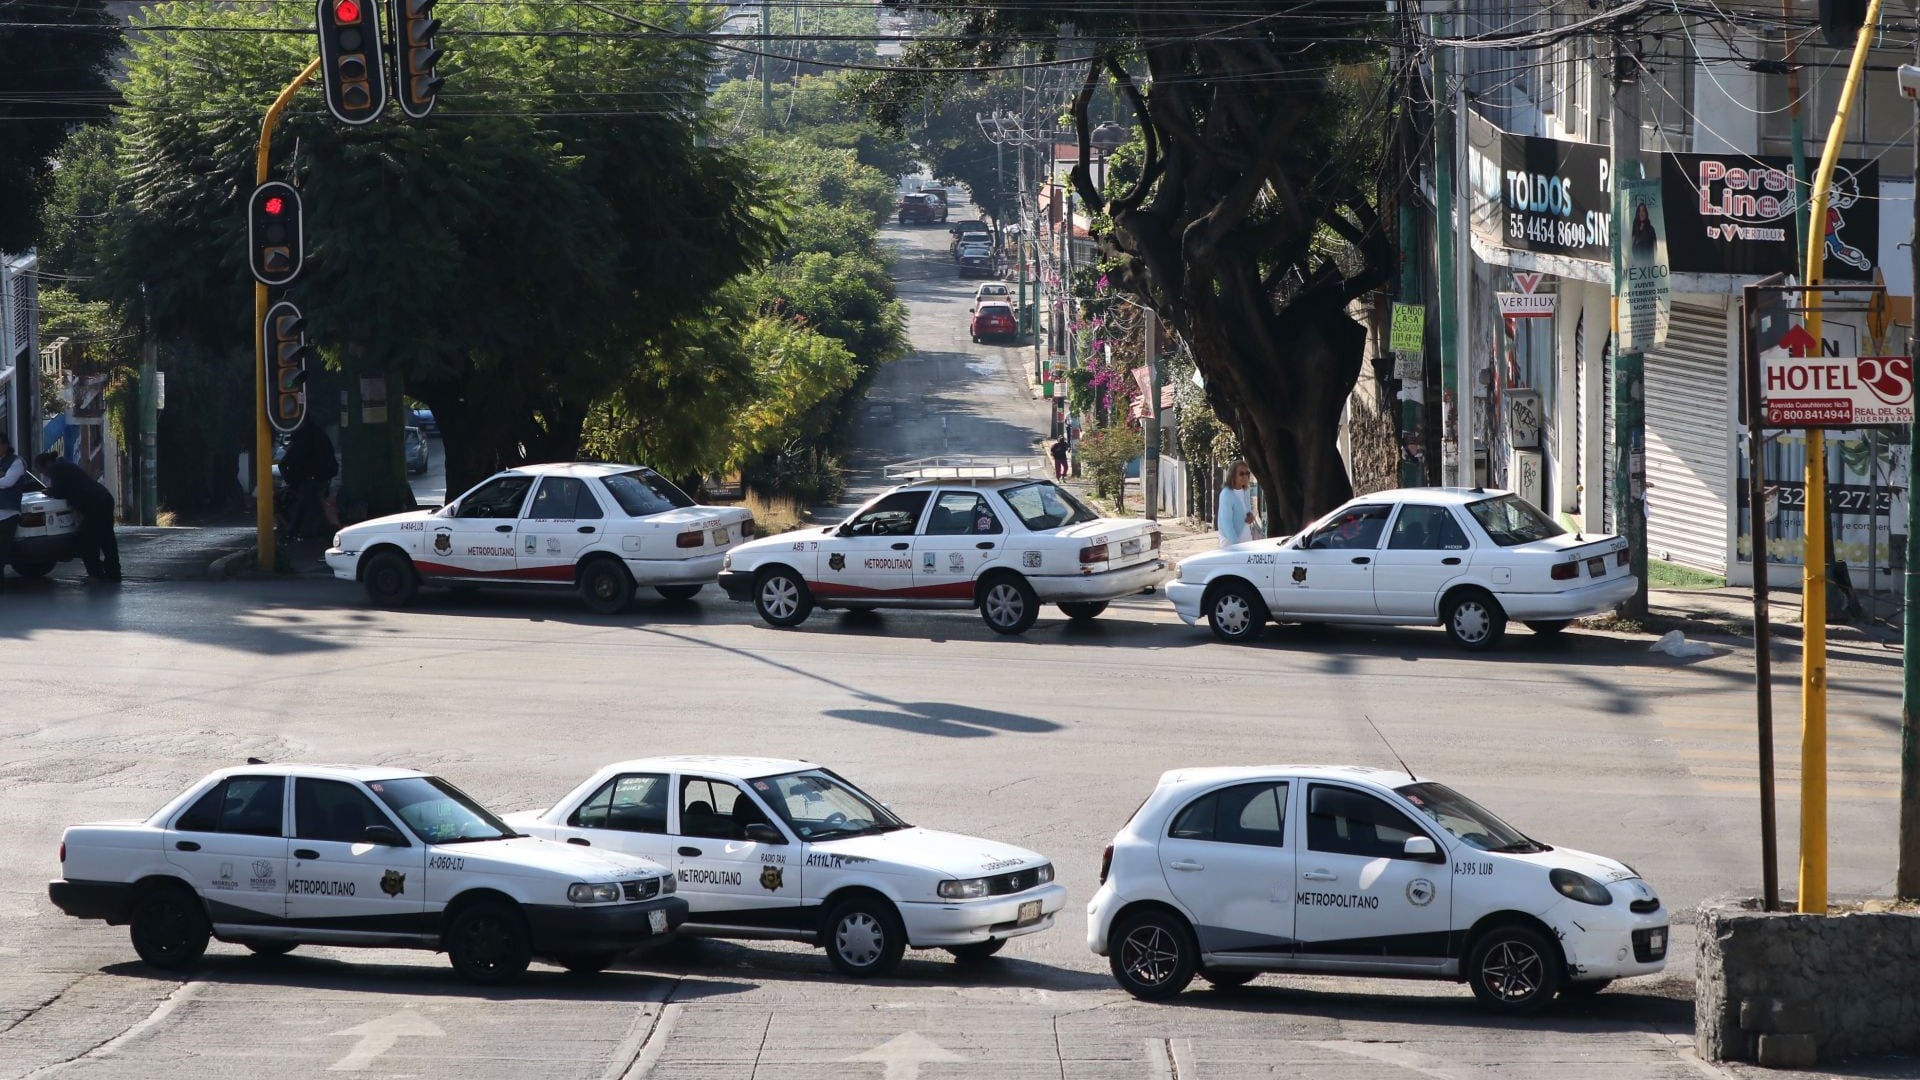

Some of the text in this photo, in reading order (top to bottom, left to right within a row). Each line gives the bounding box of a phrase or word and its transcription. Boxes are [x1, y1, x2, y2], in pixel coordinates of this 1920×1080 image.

[1700, 160, 1796, 192] Persi
[1506, 170, 1572, 217] TOLDOS
[1700, 187, 1780, 218] Line
[1510, 213, 1586, 249] 55 4454 8699
[1585, 210, 1611, 247] SIN
[1707, 226, 1720, 239] by
[1738, 227, 1785, 241] VERTILUX
[1501, 297, 1554, 307] VERTILUX
[1394, 305, 1423, 316] VENDO
[1395, 314, 1419, 324] CASA
[1767, 365, 1857, 390] HOTEL
[1854, 407, 1913, 416] REAL DEL SOL
[467, 546, 515, 557] METROPOLITANO
[792, 542, 804, 551] A89
[864, 558, 912, 569] METROPOLITANO
[429, 855, 466, 871] A-060-LTJ
[761, 853, 786, 864] RADIO TAXI
[806, 853, 842, 868] A111LTK
[1454, 862, 1493, 875] A-395 LUB
[677, 868, 741, 886] METROPOLITANO
[287, 879, 355, 897] METROPOLITANO
[1296, 891, 1379, 910] METROPOLITANO
